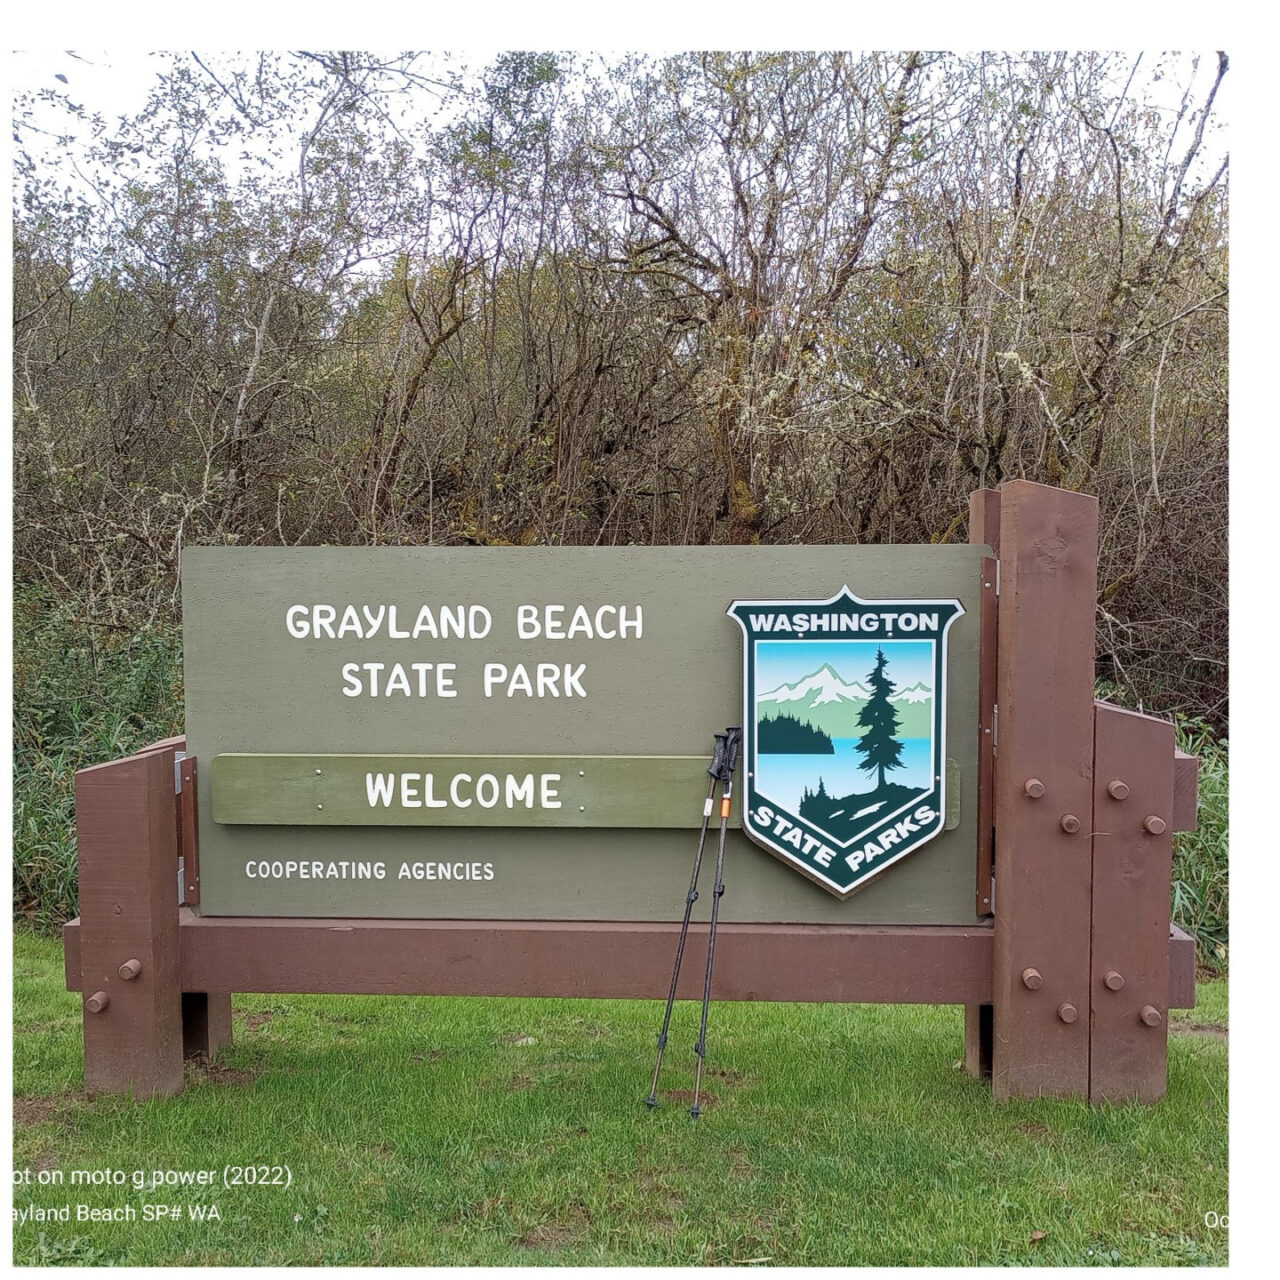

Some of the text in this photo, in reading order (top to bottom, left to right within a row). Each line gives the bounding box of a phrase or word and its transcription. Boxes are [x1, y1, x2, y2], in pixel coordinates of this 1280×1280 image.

[285, 604, 643, 640] GRAYLAND BEACH
[749, 612, 940, 634] WASHINGTON
[341, 662, 587, 698] STATE PARK
[365, 772, 562, 809] WELCOME
[753, 804, 936, 873] STATE PARKS
[245, 860, 495, 881] COOPERATING AGENCIES
